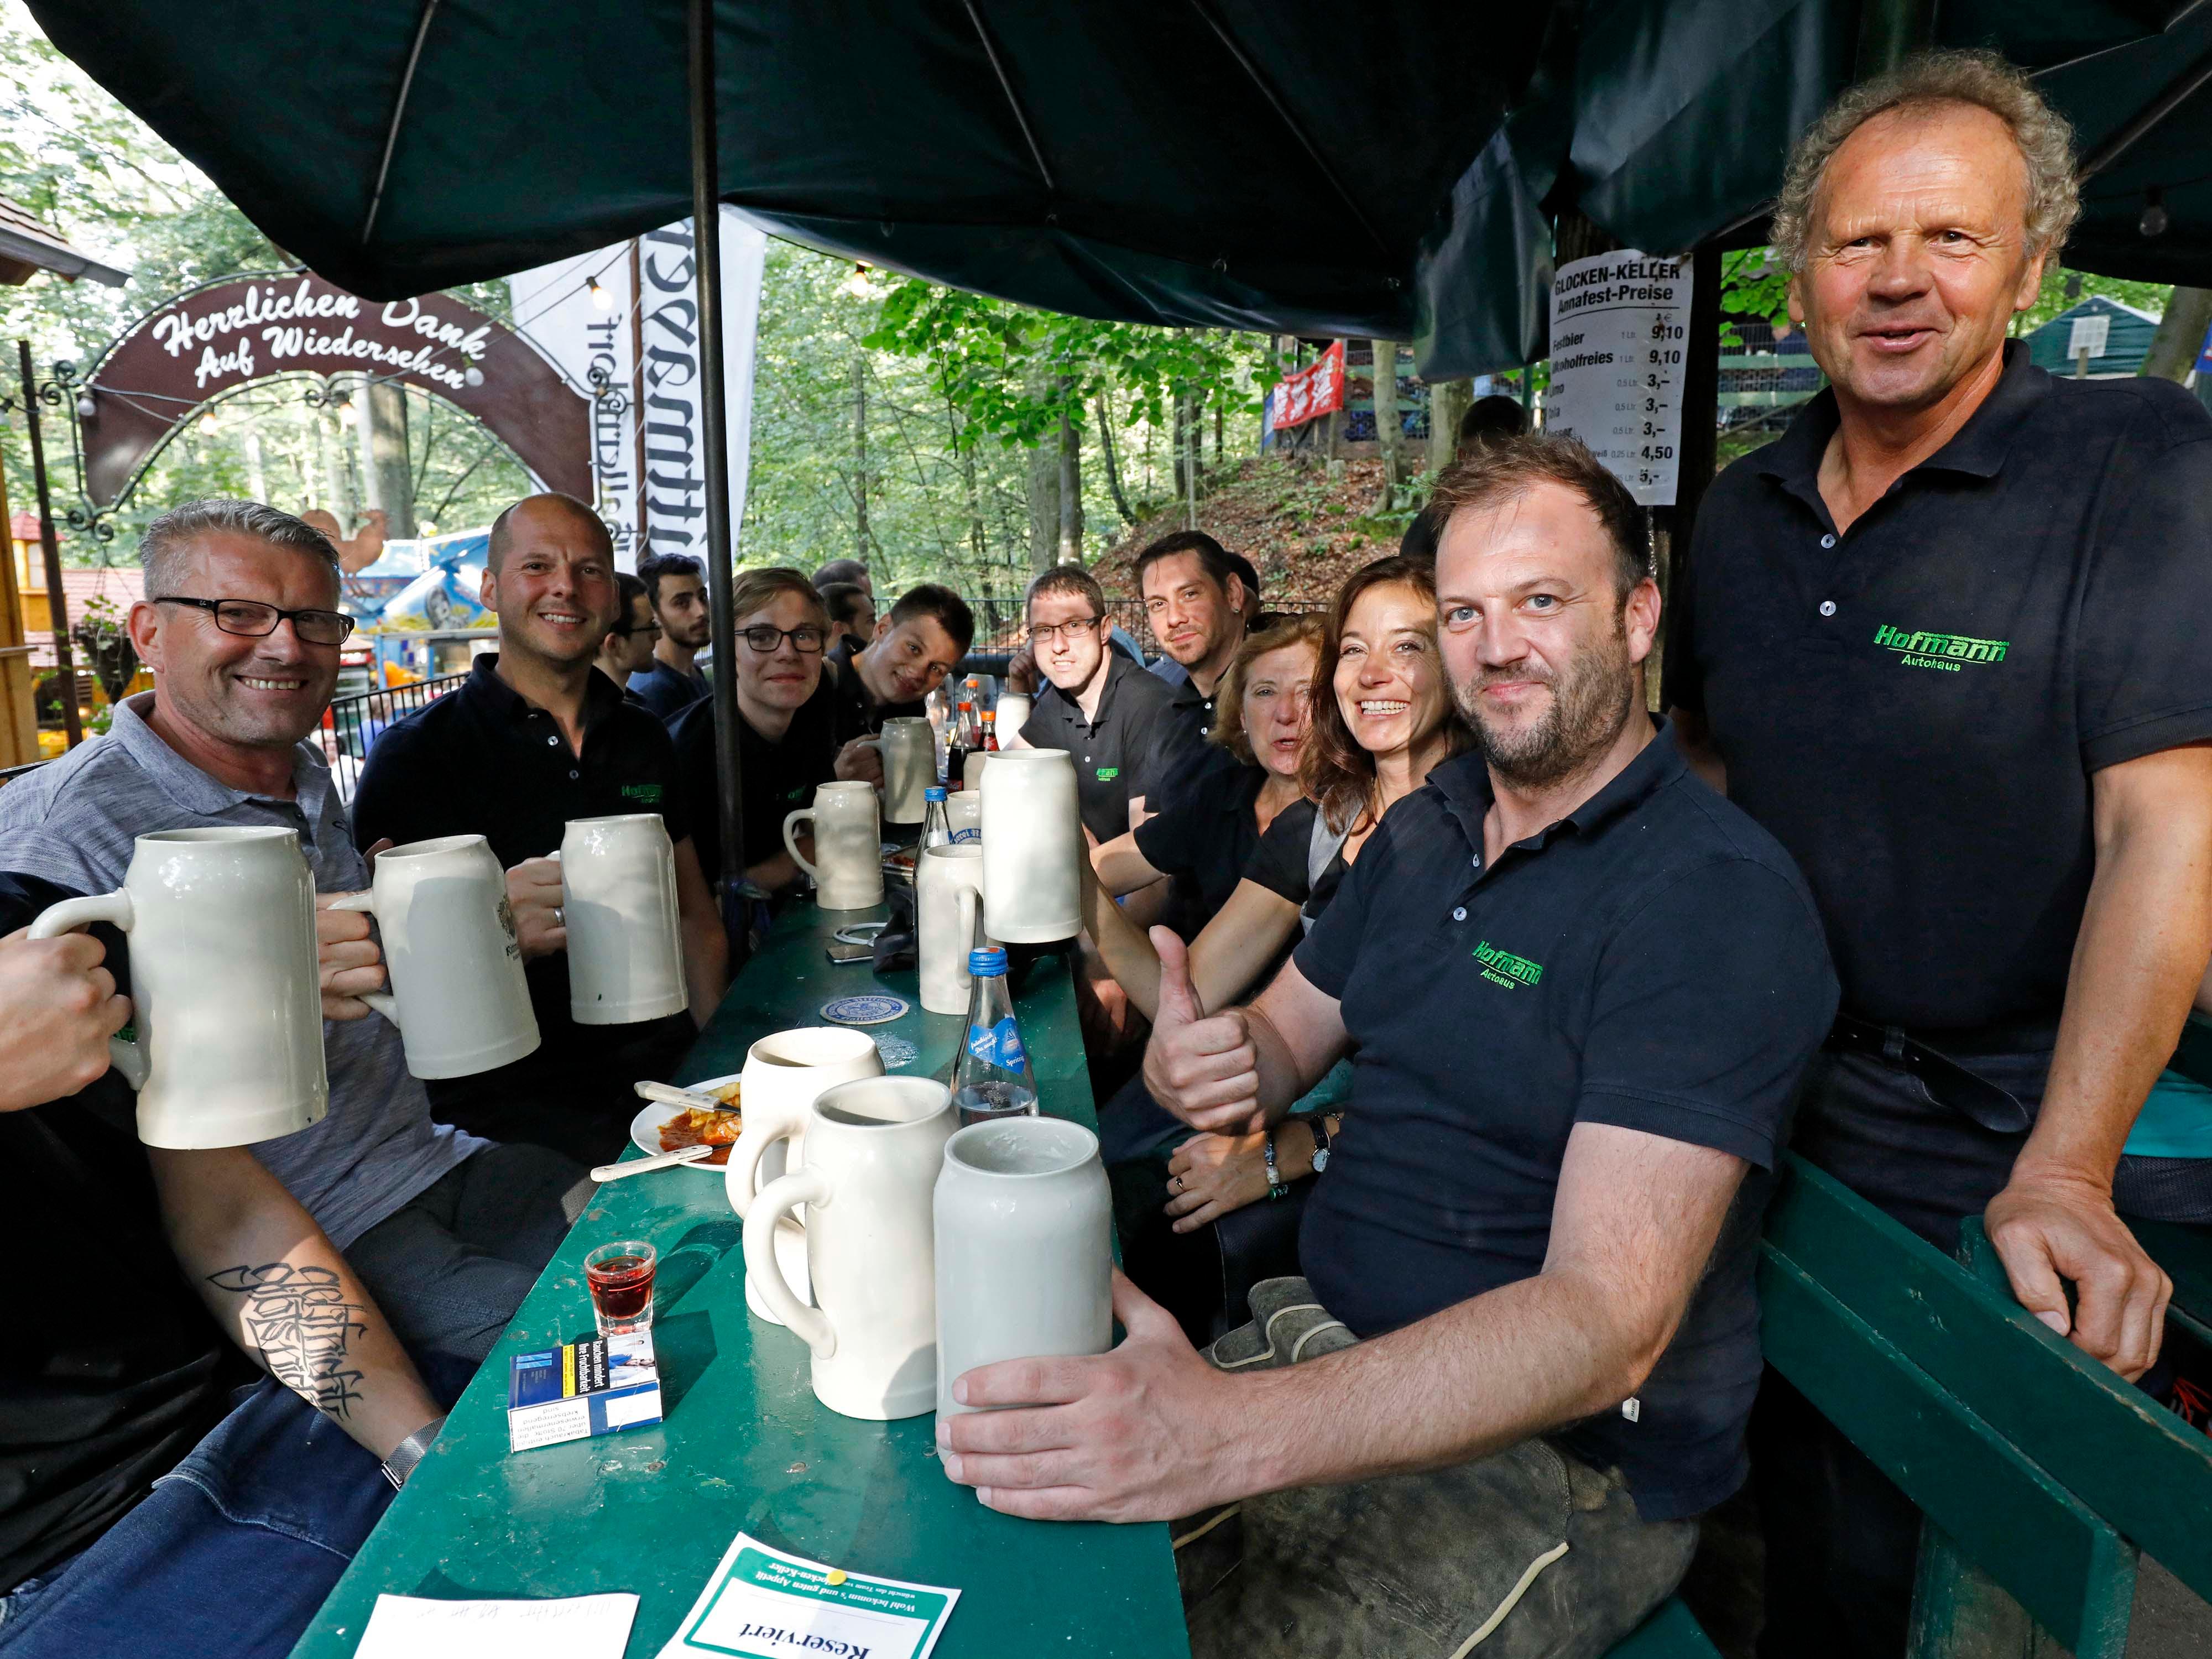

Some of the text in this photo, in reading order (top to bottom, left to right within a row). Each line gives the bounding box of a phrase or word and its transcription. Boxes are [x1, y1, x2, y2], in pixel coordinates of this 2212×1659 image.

[1555, 262, 1681, 295] GLOCKEN-KELLER
[1557, 284, 1673, 314] Annafest-Preise
[382, 297, 491, 359] Dank
[1651, 326, 1684, 342] 9,10
[195, 325, 465, 389] Auf Wiedersehen
[1649, 349, 1681, 366] 9,10
[1641, 445, 1673, 461] 4,50
[1874, 624, 2010, 662] Hofmann
[1901, 654, 1961, 672] Autohaus
[1472, 940, 1544, 985] Hofmann
[578, 1343, 591, 1393] Ihre Fruchtbarkeit
[593, 1340, 606, 1387] Rauchen mindert
[755, 1571, 792, 1587] Appetit
[768, 1562, 830, 1586] locken-Keller
[792, 1581, 819, 1593] guten
[819, 1587, 839, 1596] und
[855, 1583, 874, 1592] Team
[890, 1602, 916, 1613] Wohl
[739, 1623, 872, 1659] Reserviert
